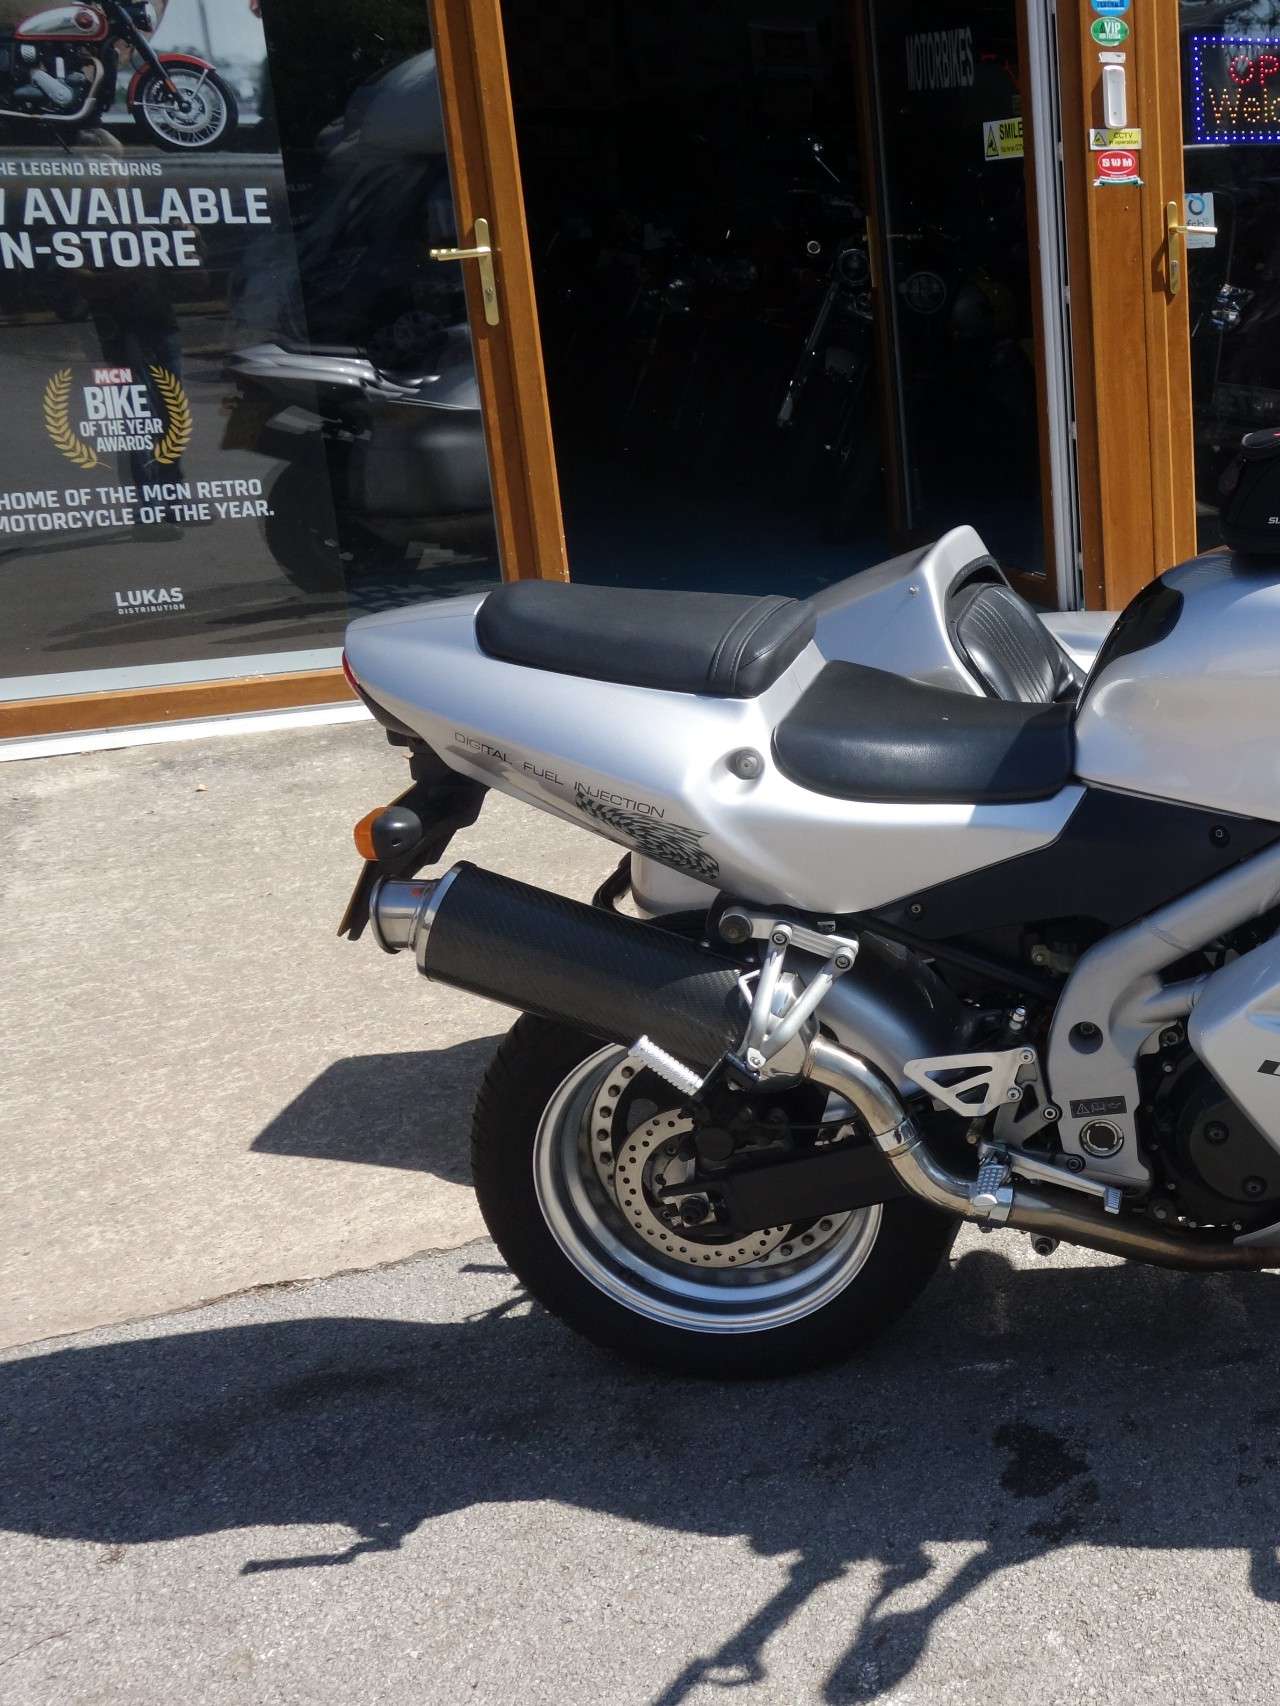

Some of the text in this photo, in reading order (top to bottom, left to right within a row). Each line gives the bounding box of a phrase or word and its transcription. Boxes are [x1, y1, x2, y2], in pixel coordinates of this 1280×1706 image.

[1104, 22, 1121, 33] VIP
[905, 27, 974, 91] MOTORBIKES
[1000, 121, 1024, 140] SMILE
[1113, 131, 1133, 139] CCTV
[21, 162, 85, 176] LEGEND
[89, 162, 163, 176] RETURNS
[1102, 158, 1133, 168] SWM
[23, 187, 272, 225] AVAILABLE
[95, 369, 132, 383] MCN
[83, 385, 152, 420] BIKE
[80, 418, 164, 437] OF THE YEAR
[97, 435, 154, 452] AWARDS
[0, 478, 262, 510] HOME OF THE MCN RETRO
[0, 499, 275, 533] MOTORCYCLE OF THE YEAR.
[115, 587, 184, 607] LUKAS
[118, 603, 186, 615] DISTRIBUTION
[454, 730, 665, 819] DIGITAL FUEL INJECTION
